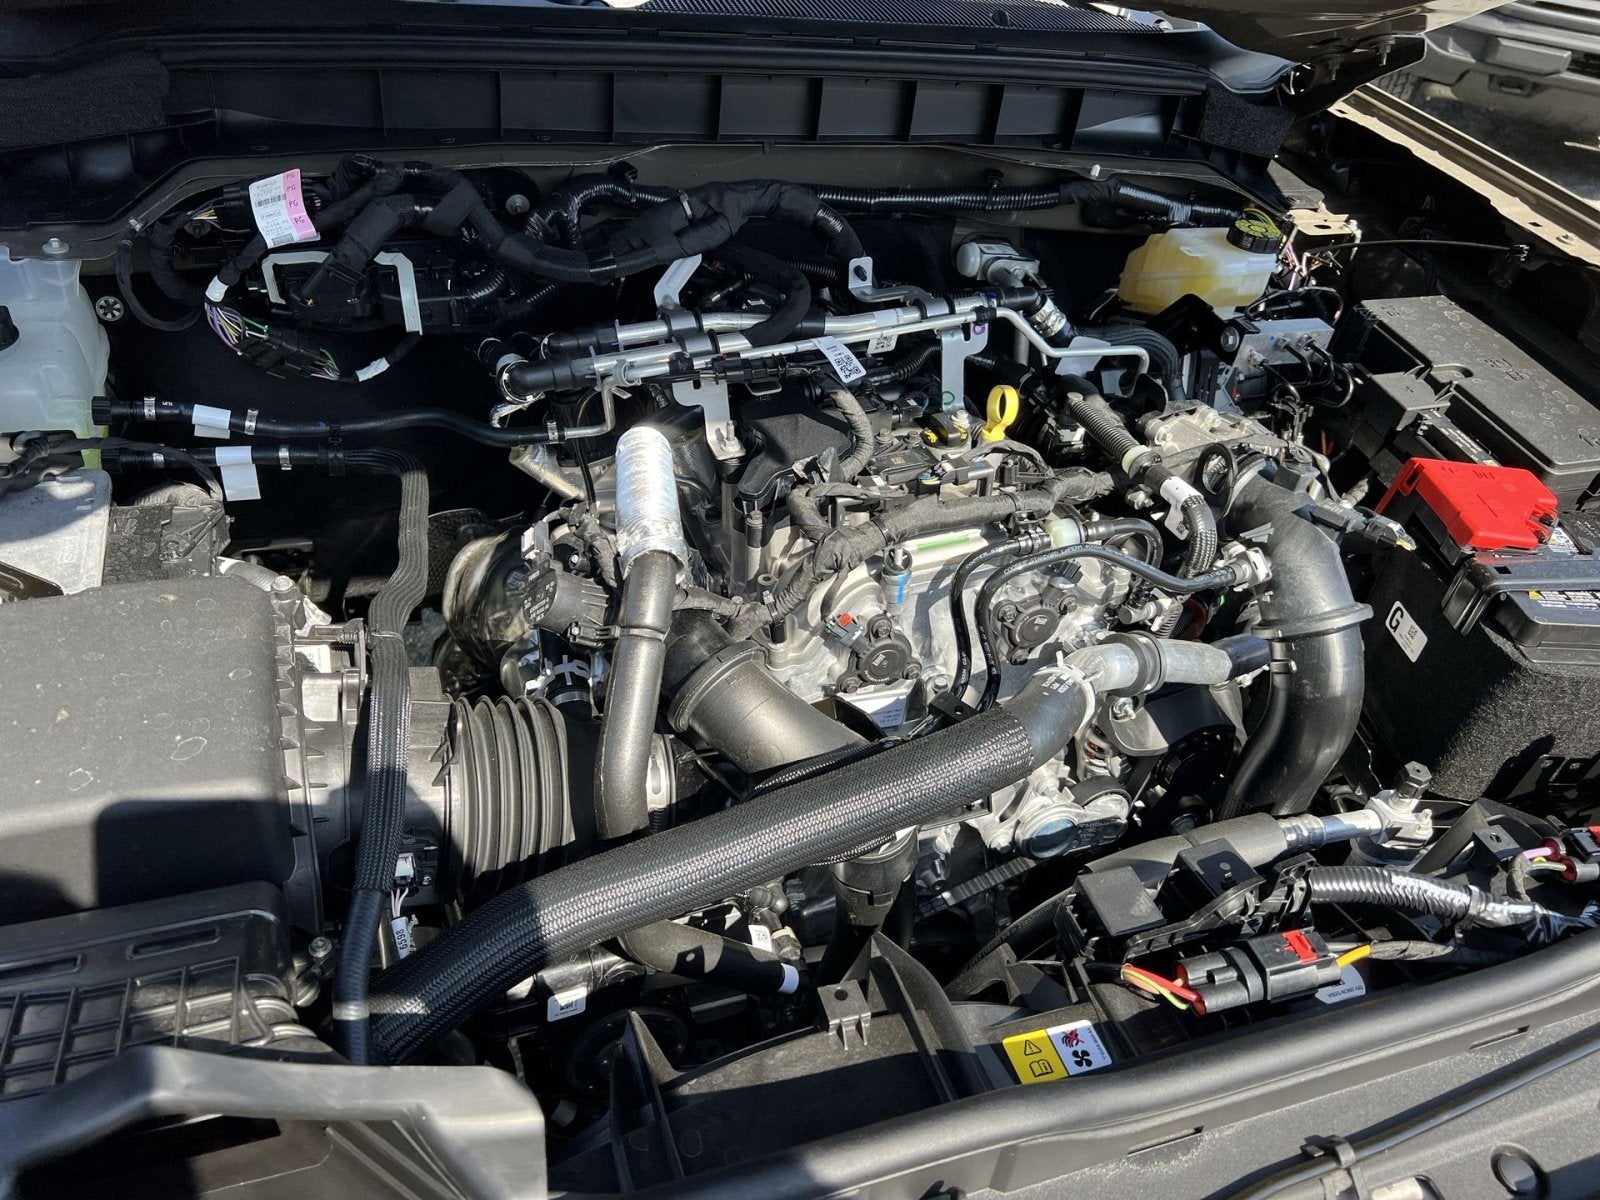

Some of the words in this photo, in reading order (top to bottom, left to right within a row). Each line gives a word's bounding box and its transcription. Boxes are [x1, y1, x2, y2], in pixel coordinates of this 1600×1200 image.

[288, 199, 299, 208] PG
[293, 216, 306, 224] PG
[1389, 606, 1404, 633] G
[395, 929, 408, 950] 6598
